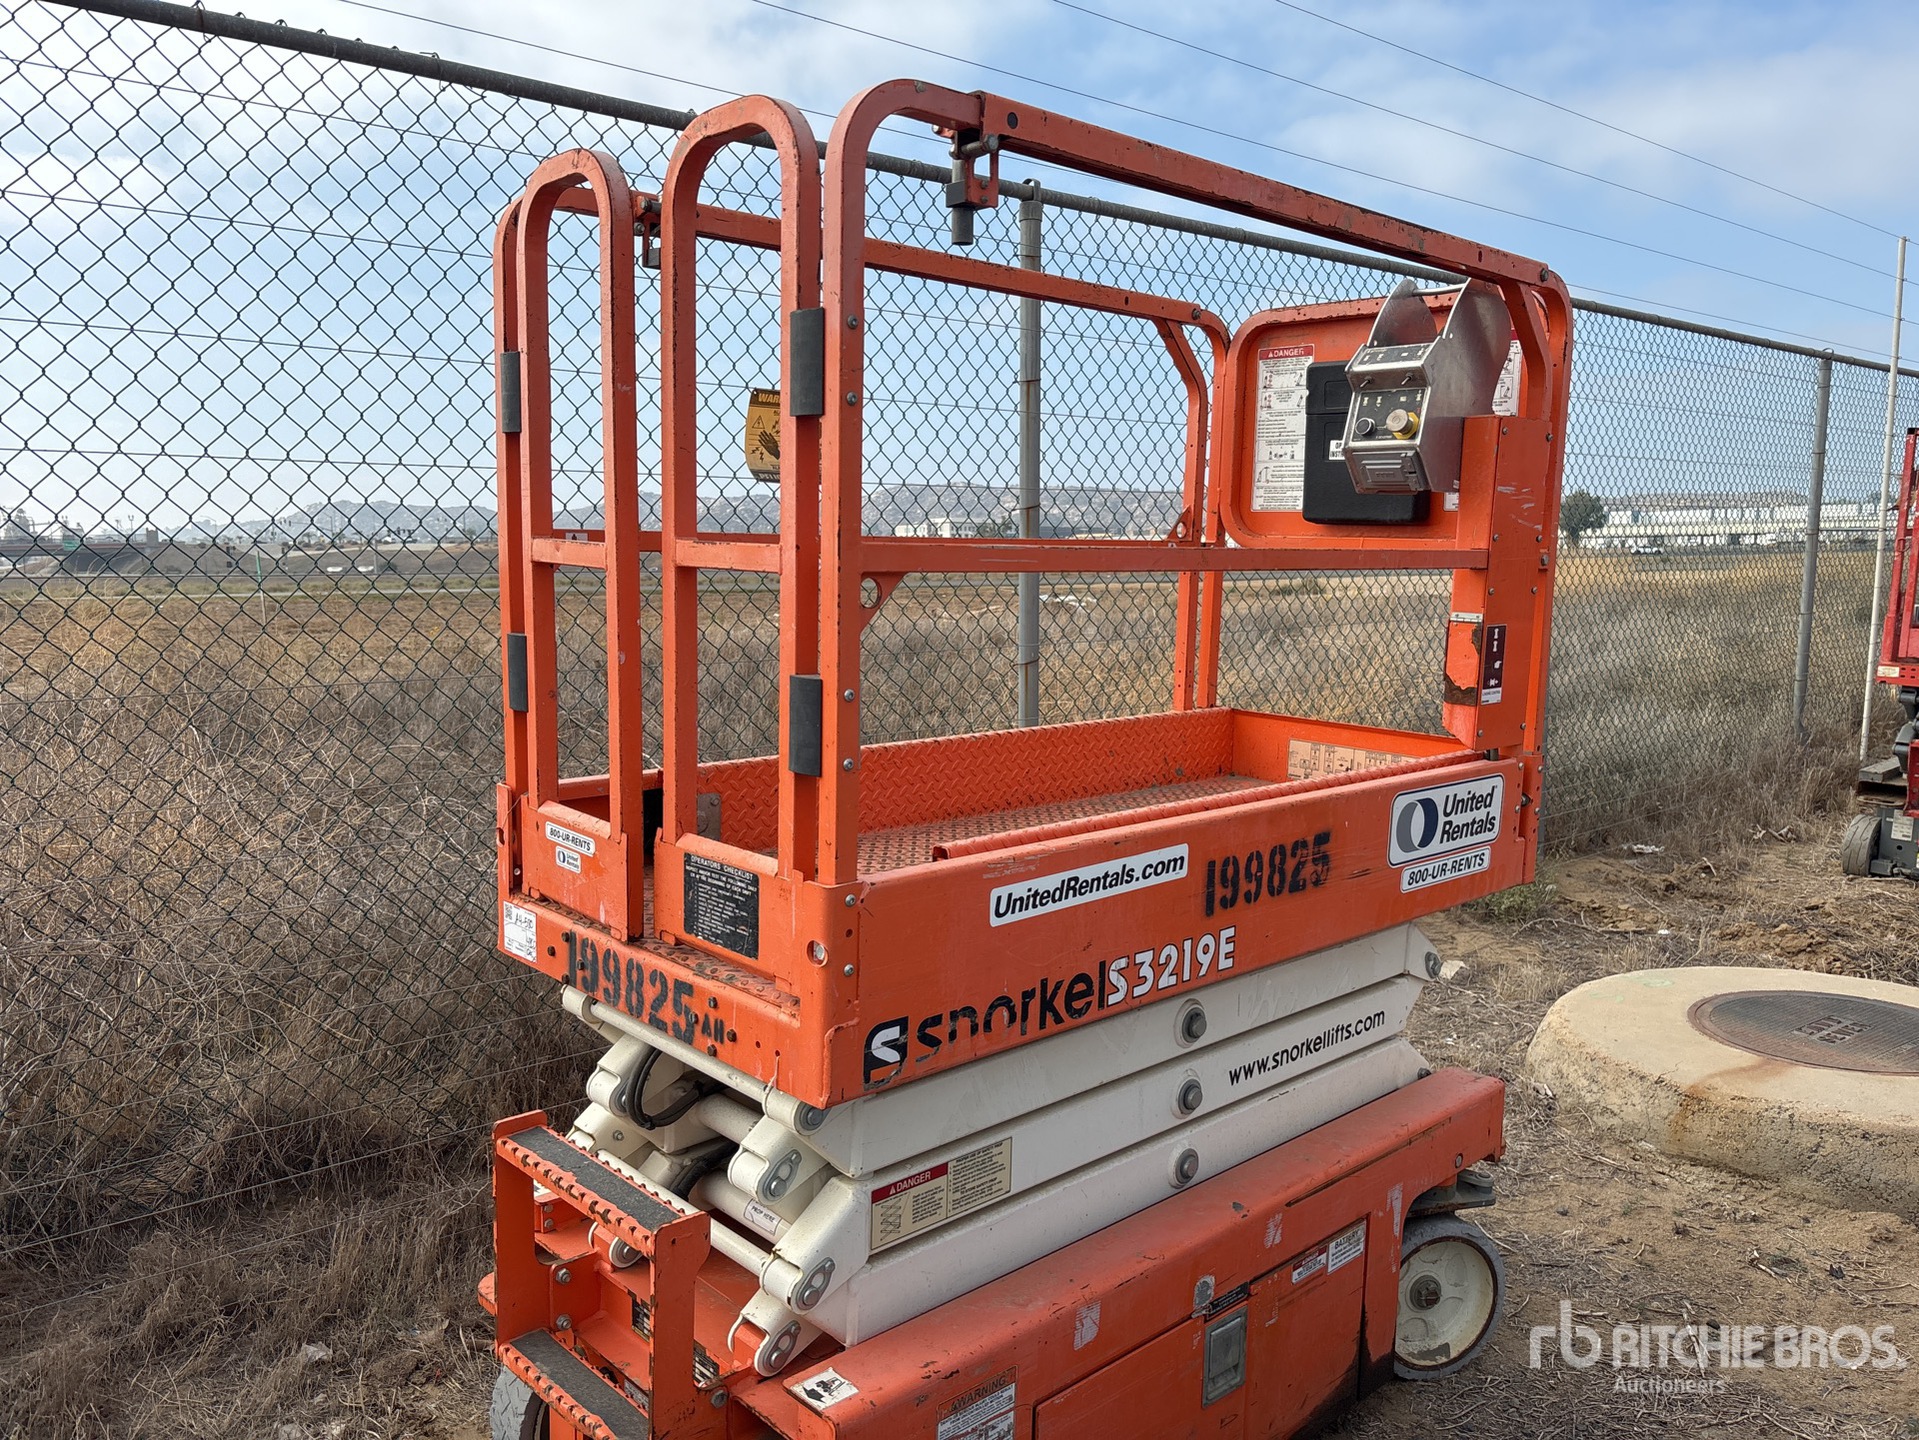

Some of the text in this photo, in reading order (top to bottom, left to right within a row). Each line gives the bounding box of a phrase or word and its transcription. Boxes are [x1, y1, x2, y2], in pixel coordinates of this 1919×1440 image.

[758, 393, 780, 403] WAR
[1443, 785, 1495, 817] United
[550, 828, 591, 851] 800-UR-RENTS
[1440, 810, 1496, 844] Rentals
[690, 856, 753, 880] OPERATORS CHECKLIST
[1205, 832, 1331, 917] 199825
[1408, 852, 1485, 886] 800-UR-RENTS
[994, 855, 1184, 918] UnitedRentals.com
[1106, 925, 1237, 1008] S3219E
[568, 930, 696, 1045] 199825
[916, 961, 1106, 1062] snorkel
[1228, 1010, 1385, 1086] www.snorkellifts.com
[896, 1171, 931, 1192] DANGER
[957, 1375, 1006, 1407] WARNING
